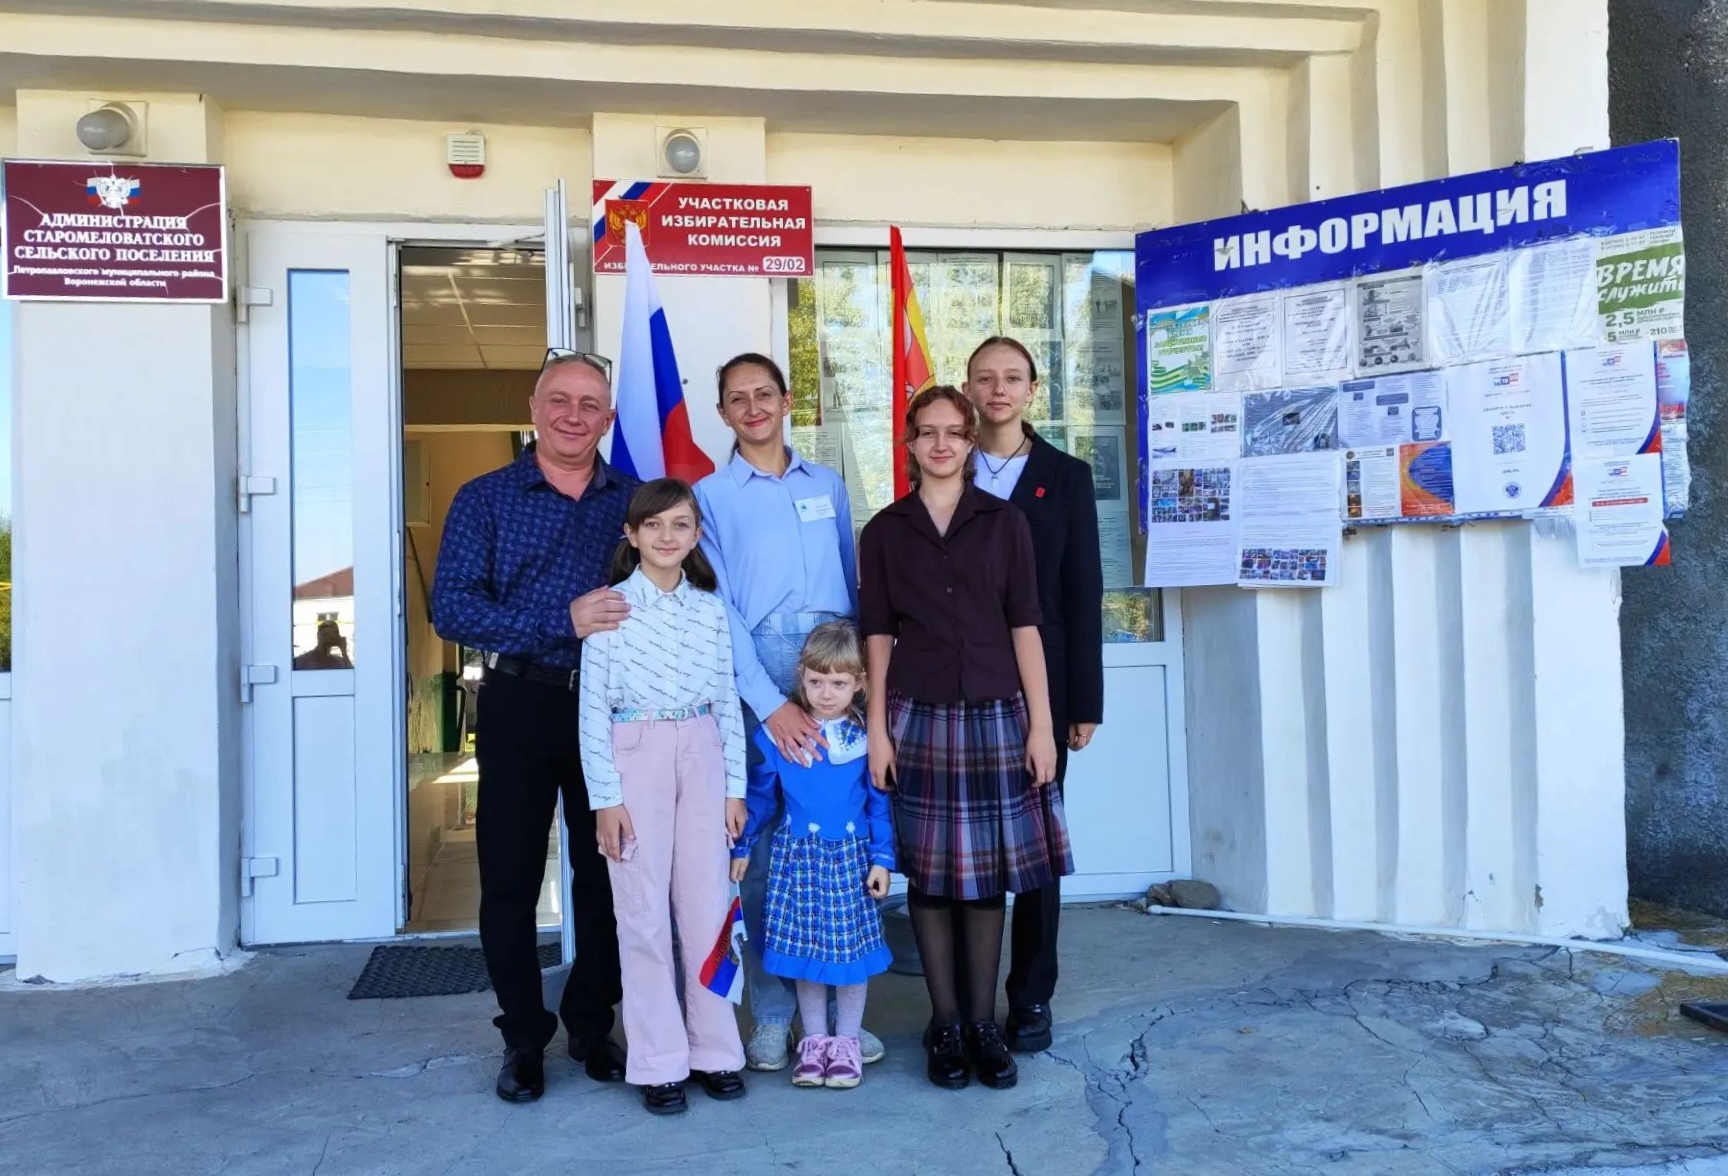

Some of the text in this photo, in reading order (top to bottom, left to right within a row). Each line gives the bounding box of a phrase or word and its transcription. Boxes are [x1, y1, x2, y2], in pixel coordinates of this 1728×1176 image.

[678, 196, 789, 211] УЧАСТКОВАЯ
[39, 213, 188, 230] АДМИНИСТРАЦИЯ
[661, 214, 806, 230] ИЗБИРАТЕЛЬНАЯ
[1213, 179, 1567, 272] ИНФОРМАЦИЯ
[23, 229, 204, 246] СТАРОМЕЛОВАТСКОГО
[687, 233, 781, 247] КОМИССИЯ
[14, 246, 214, 263] СЕЛЬСКОГО ПОСЕЛЕНИЯ
[13, 265, 215, 279] Петропавловского муниципального района
[604, 257, 804, 273] ИЗБЕЛЬНОГО УЧАСТКА № 29/02
[1597, 255, 1684, 288] ВРЕМЯ
[64, 277, 167, 288] Воронежской области
[1605, 312, 1635, 328] 2,5
[1637, 309, 1657, 317] МЛН
[1607, 332, 1616, 343] 5
[1649, 327, 1668, 336] 210
